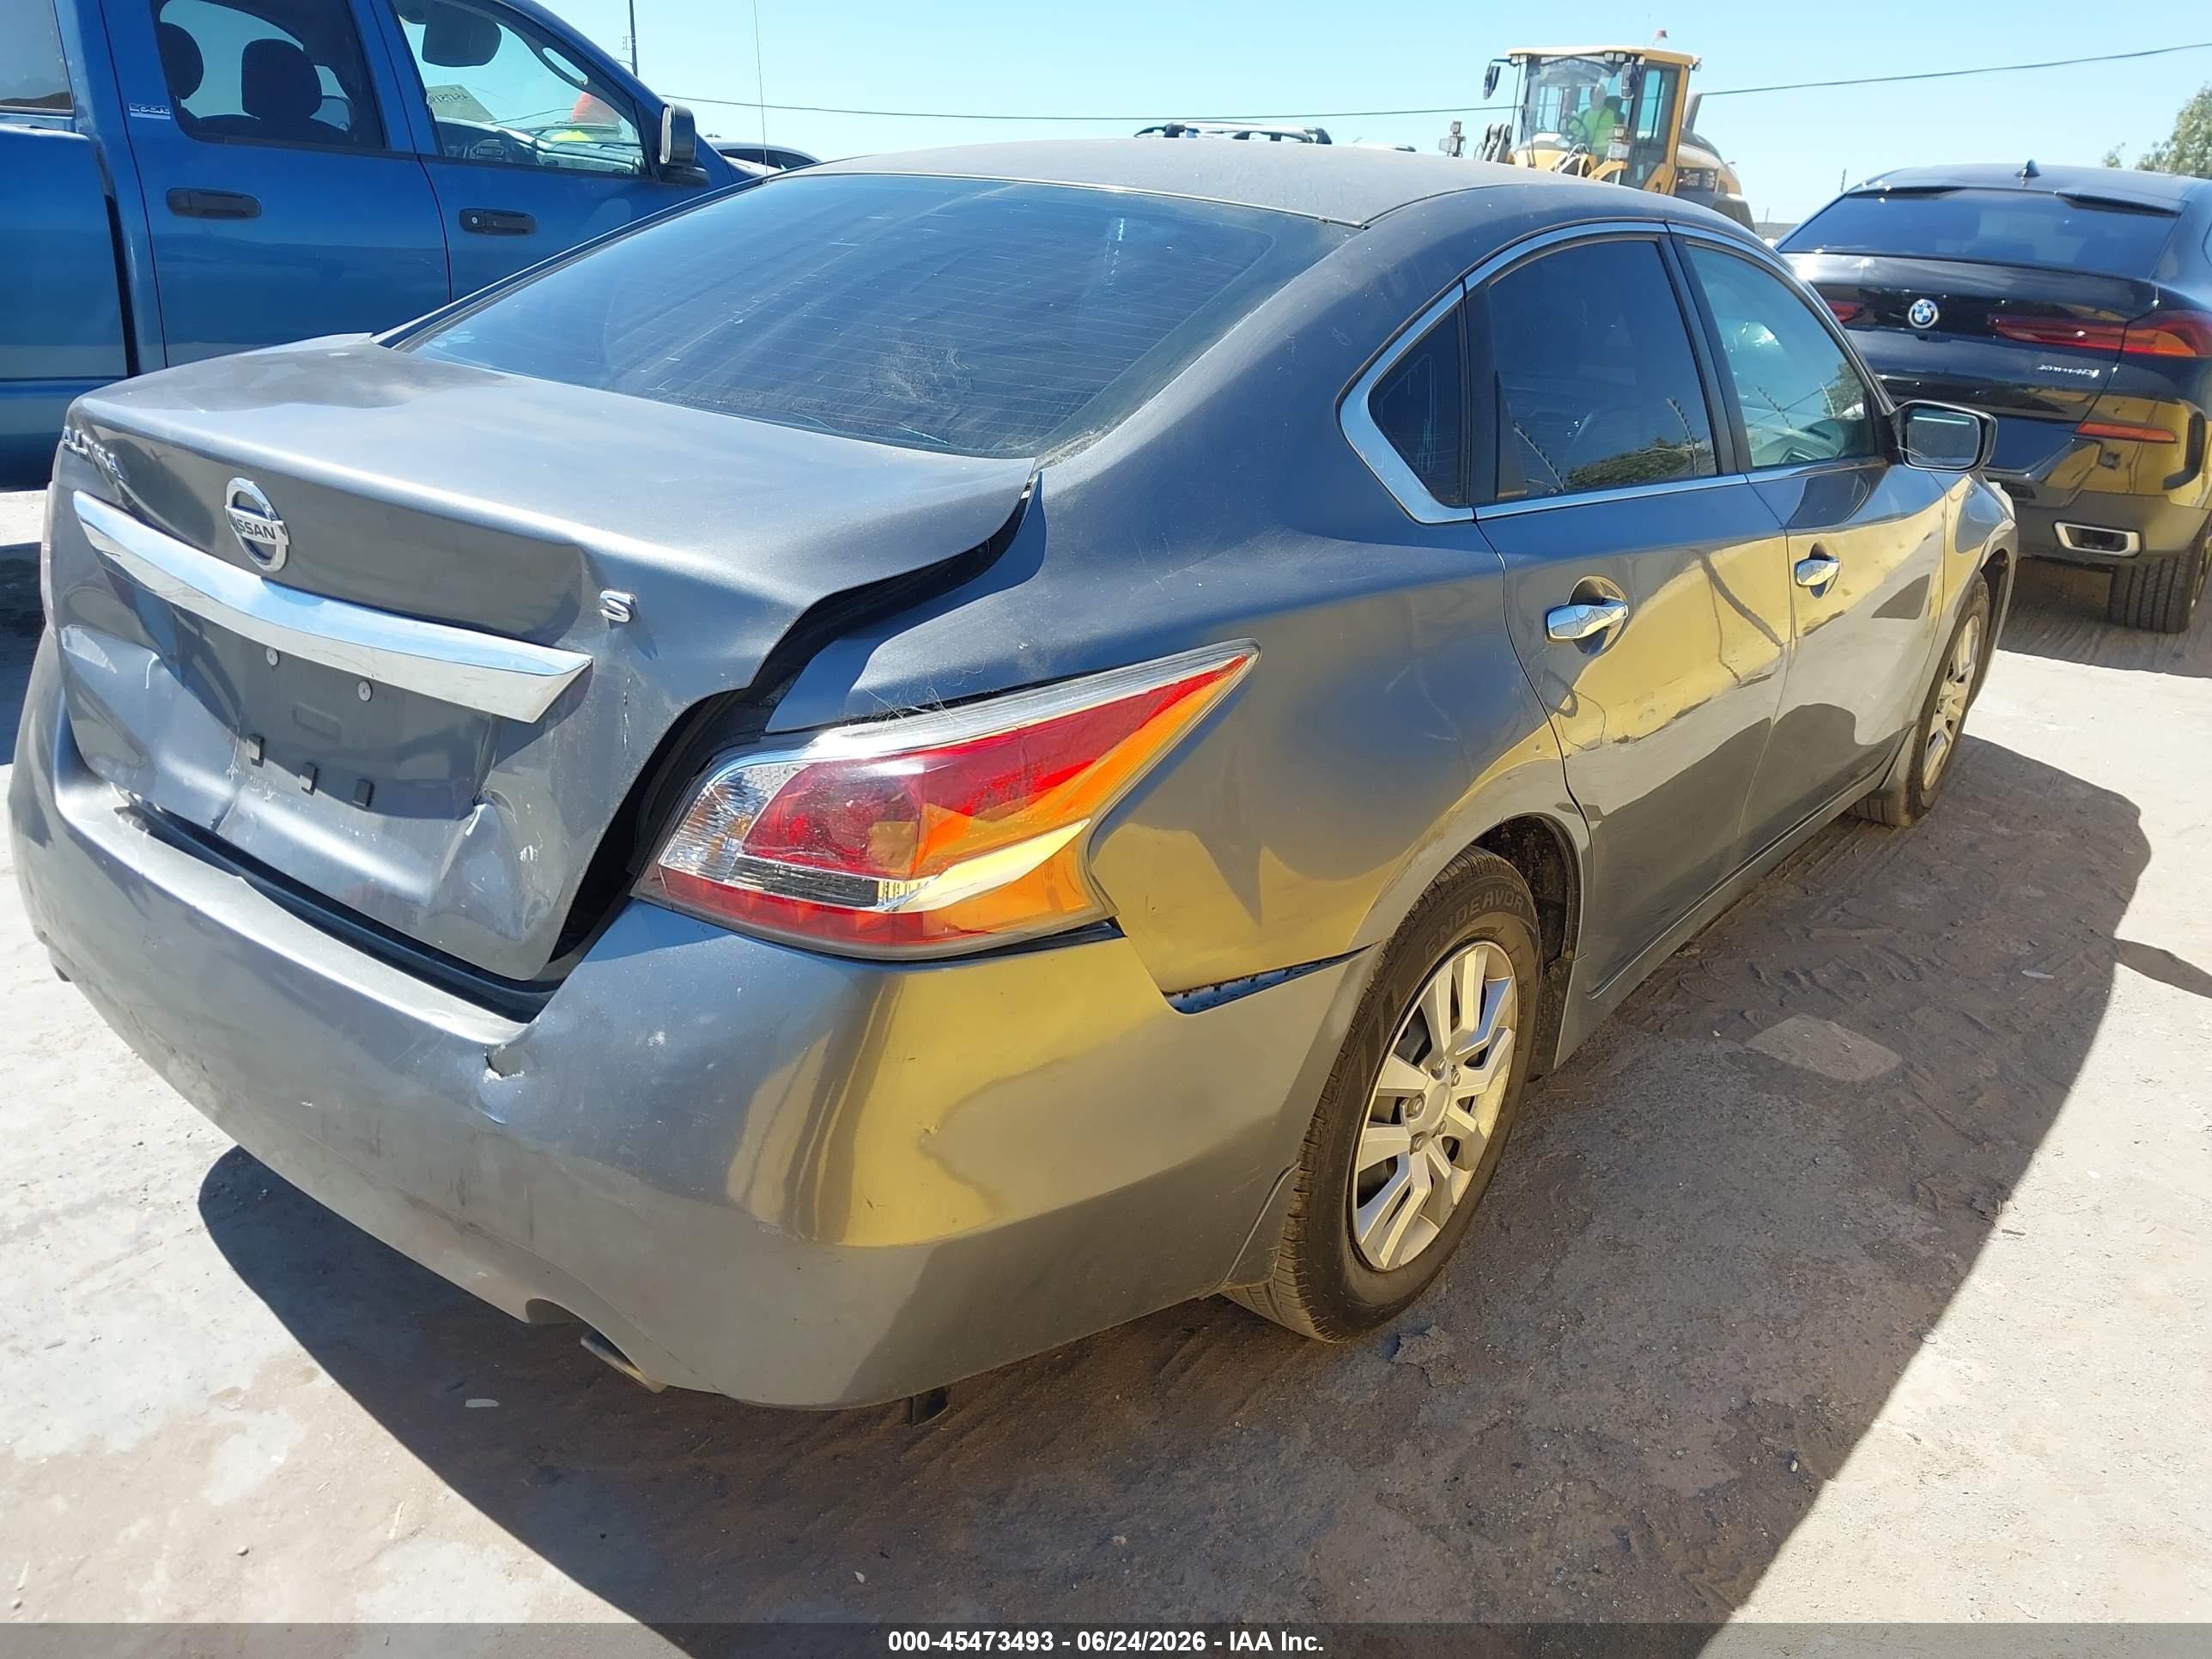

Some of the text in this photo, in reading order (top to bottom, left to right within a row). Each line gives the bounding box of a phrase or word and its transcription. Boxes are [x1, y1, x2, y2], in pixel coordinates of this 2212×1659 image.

[228, 511, 276, 540] NISSAN
[600, 590, 633, 623] S
[1424, 889, 1524, 963] ENDEAVOR
